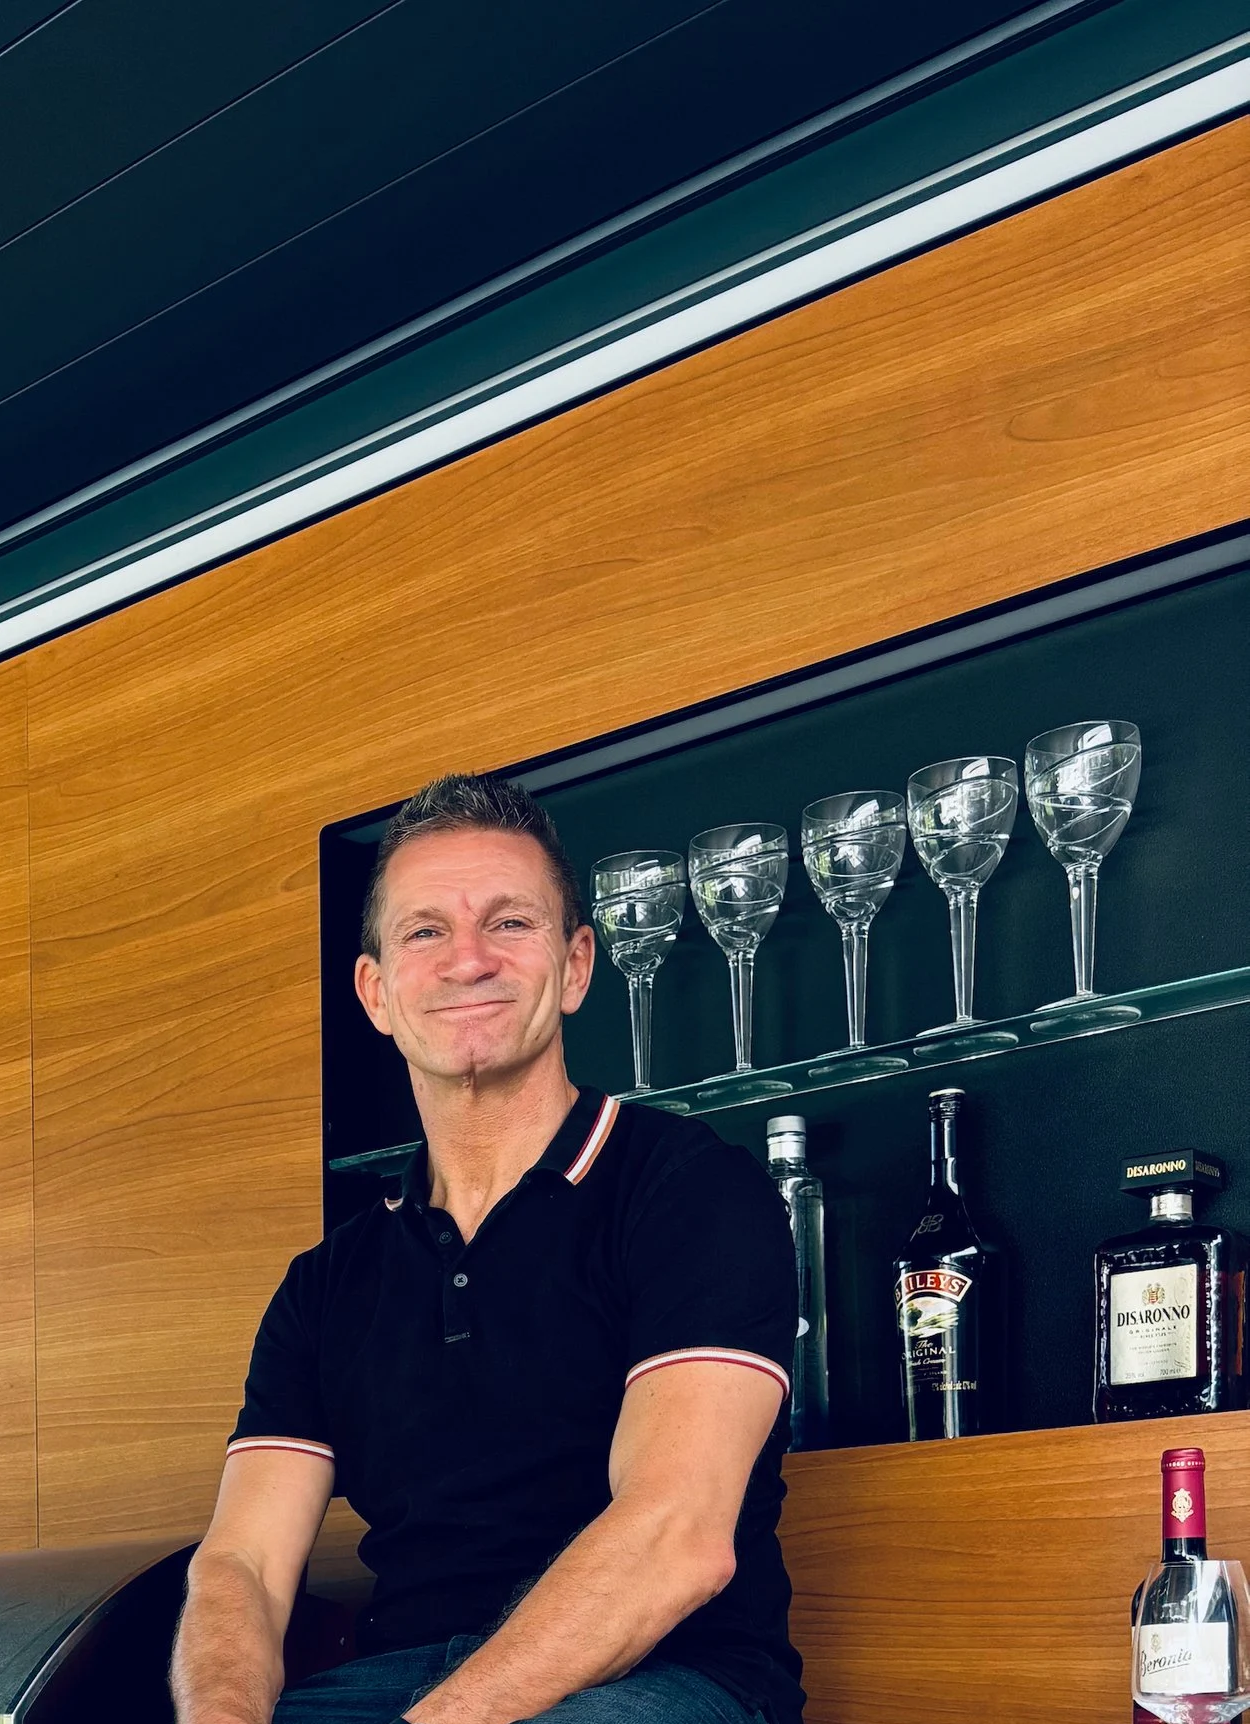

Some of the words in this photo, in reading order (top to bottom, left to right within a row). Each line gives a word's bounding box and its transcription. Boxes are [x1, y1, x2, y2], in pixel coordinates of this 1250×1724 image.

[1126, 1159, 1187, 1179] DISARONNO
[1116, 1304, 1191, 1328] DISARONNO
[901, 1345, 956, 1361] ORIGINAL
[915, 1339, 934, 1350] The
[1140, 1648, 1192, 1677] Beronia
